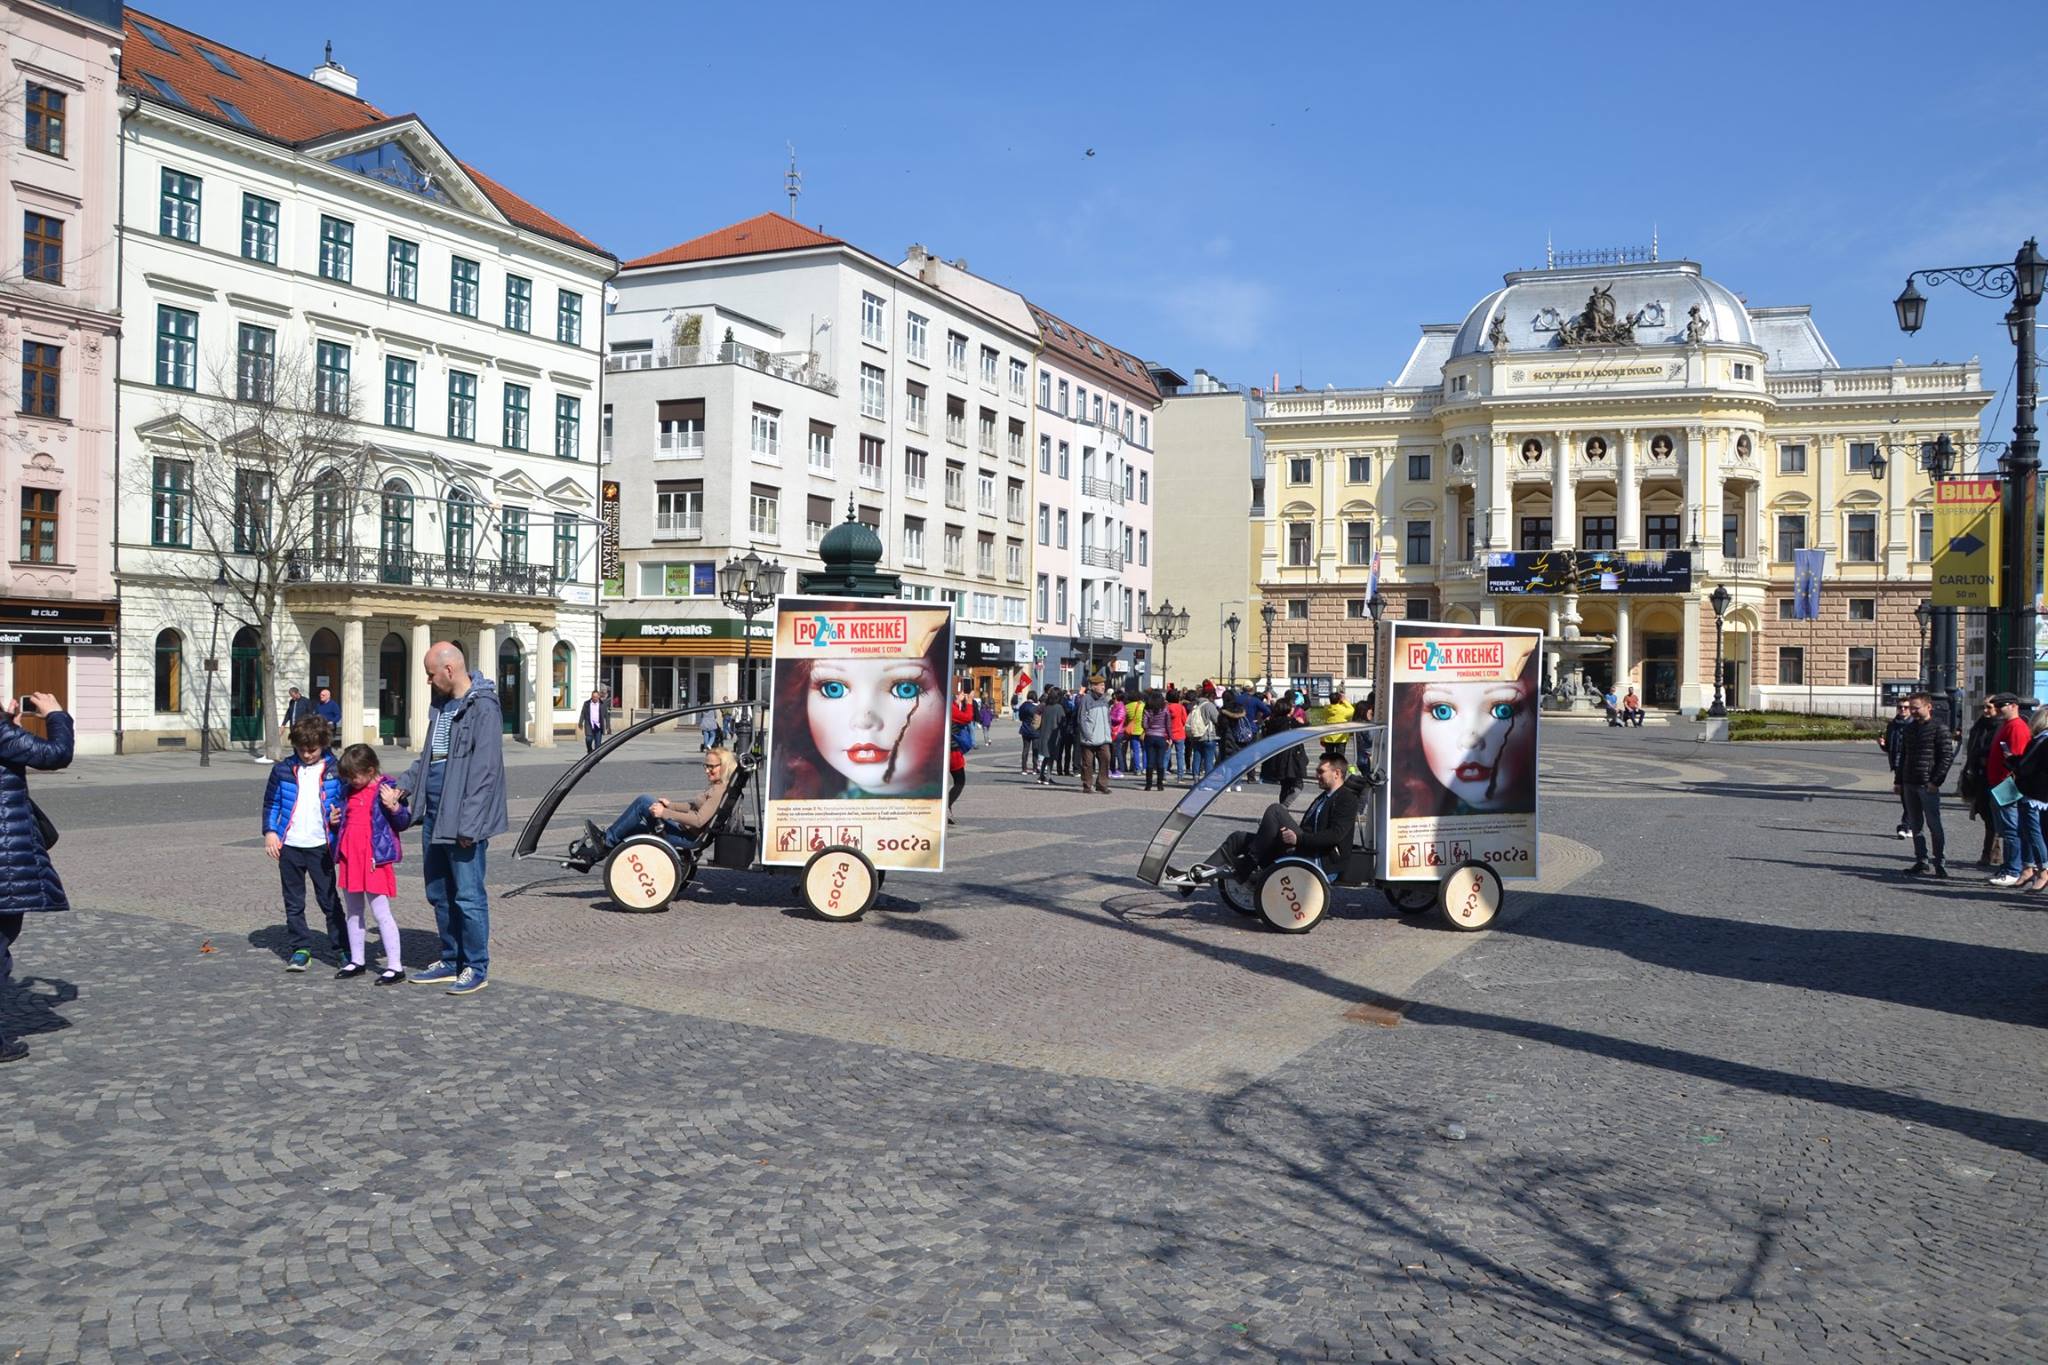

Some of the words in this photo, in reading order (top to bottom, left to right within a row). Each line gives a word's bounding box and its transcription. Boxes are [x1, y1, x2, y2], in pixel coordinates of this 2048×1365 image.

[1941, 483, 1997, 499] BILLA
[602, 501, 612, 578] RESTAURANT
[1939, 576, 1994, 585] CARLTON
[640, 624, 712, 635] McDonald's
[850, 620, 901, 639] KREHKÉ
[73, 636, 92, 644] club
[1456, 645, 1499, 663] KREHKÉ
[877, 834, 931, 851] socia
[1484, 846, 1528, 863] socia
[627, 854, 657, 898] socia
[828, 862, 850, 909] socia
[1280, 876, 1305, 920] socia
[1462, 874, 1484, 918] socia
